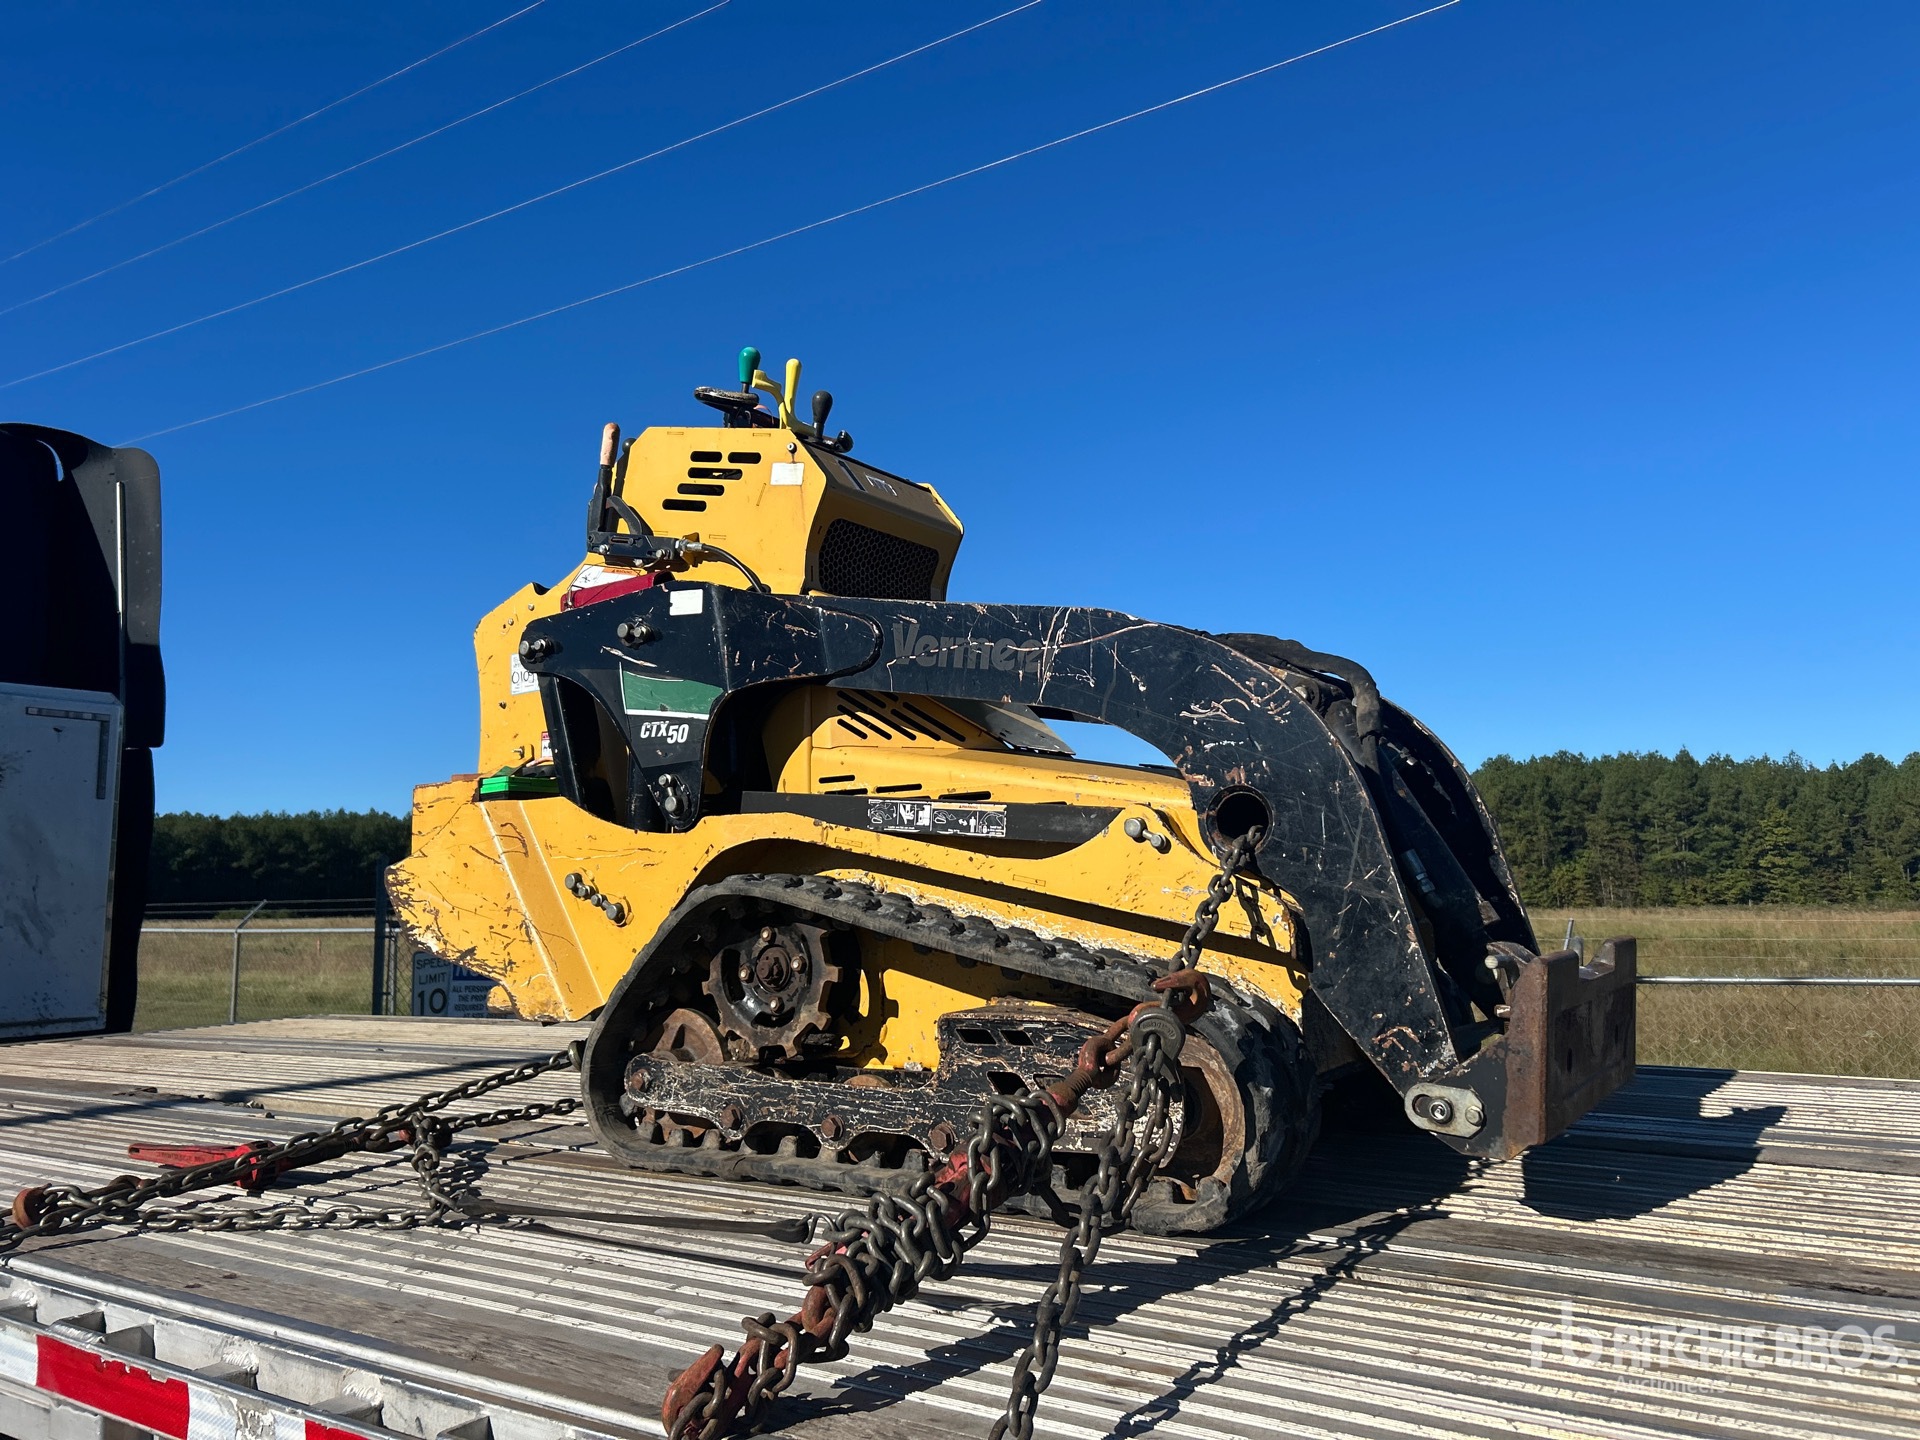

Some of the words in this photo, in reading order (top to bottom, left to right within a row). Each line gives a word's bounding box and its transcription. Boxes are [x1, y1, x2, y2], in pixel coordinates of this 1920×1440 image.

[640, 720, 690, 744] CTX50
[418, 972, 447, 985] LIMIT
[452, 985, 463, 993] ALL
[417, 987, 448, 1016] 10
